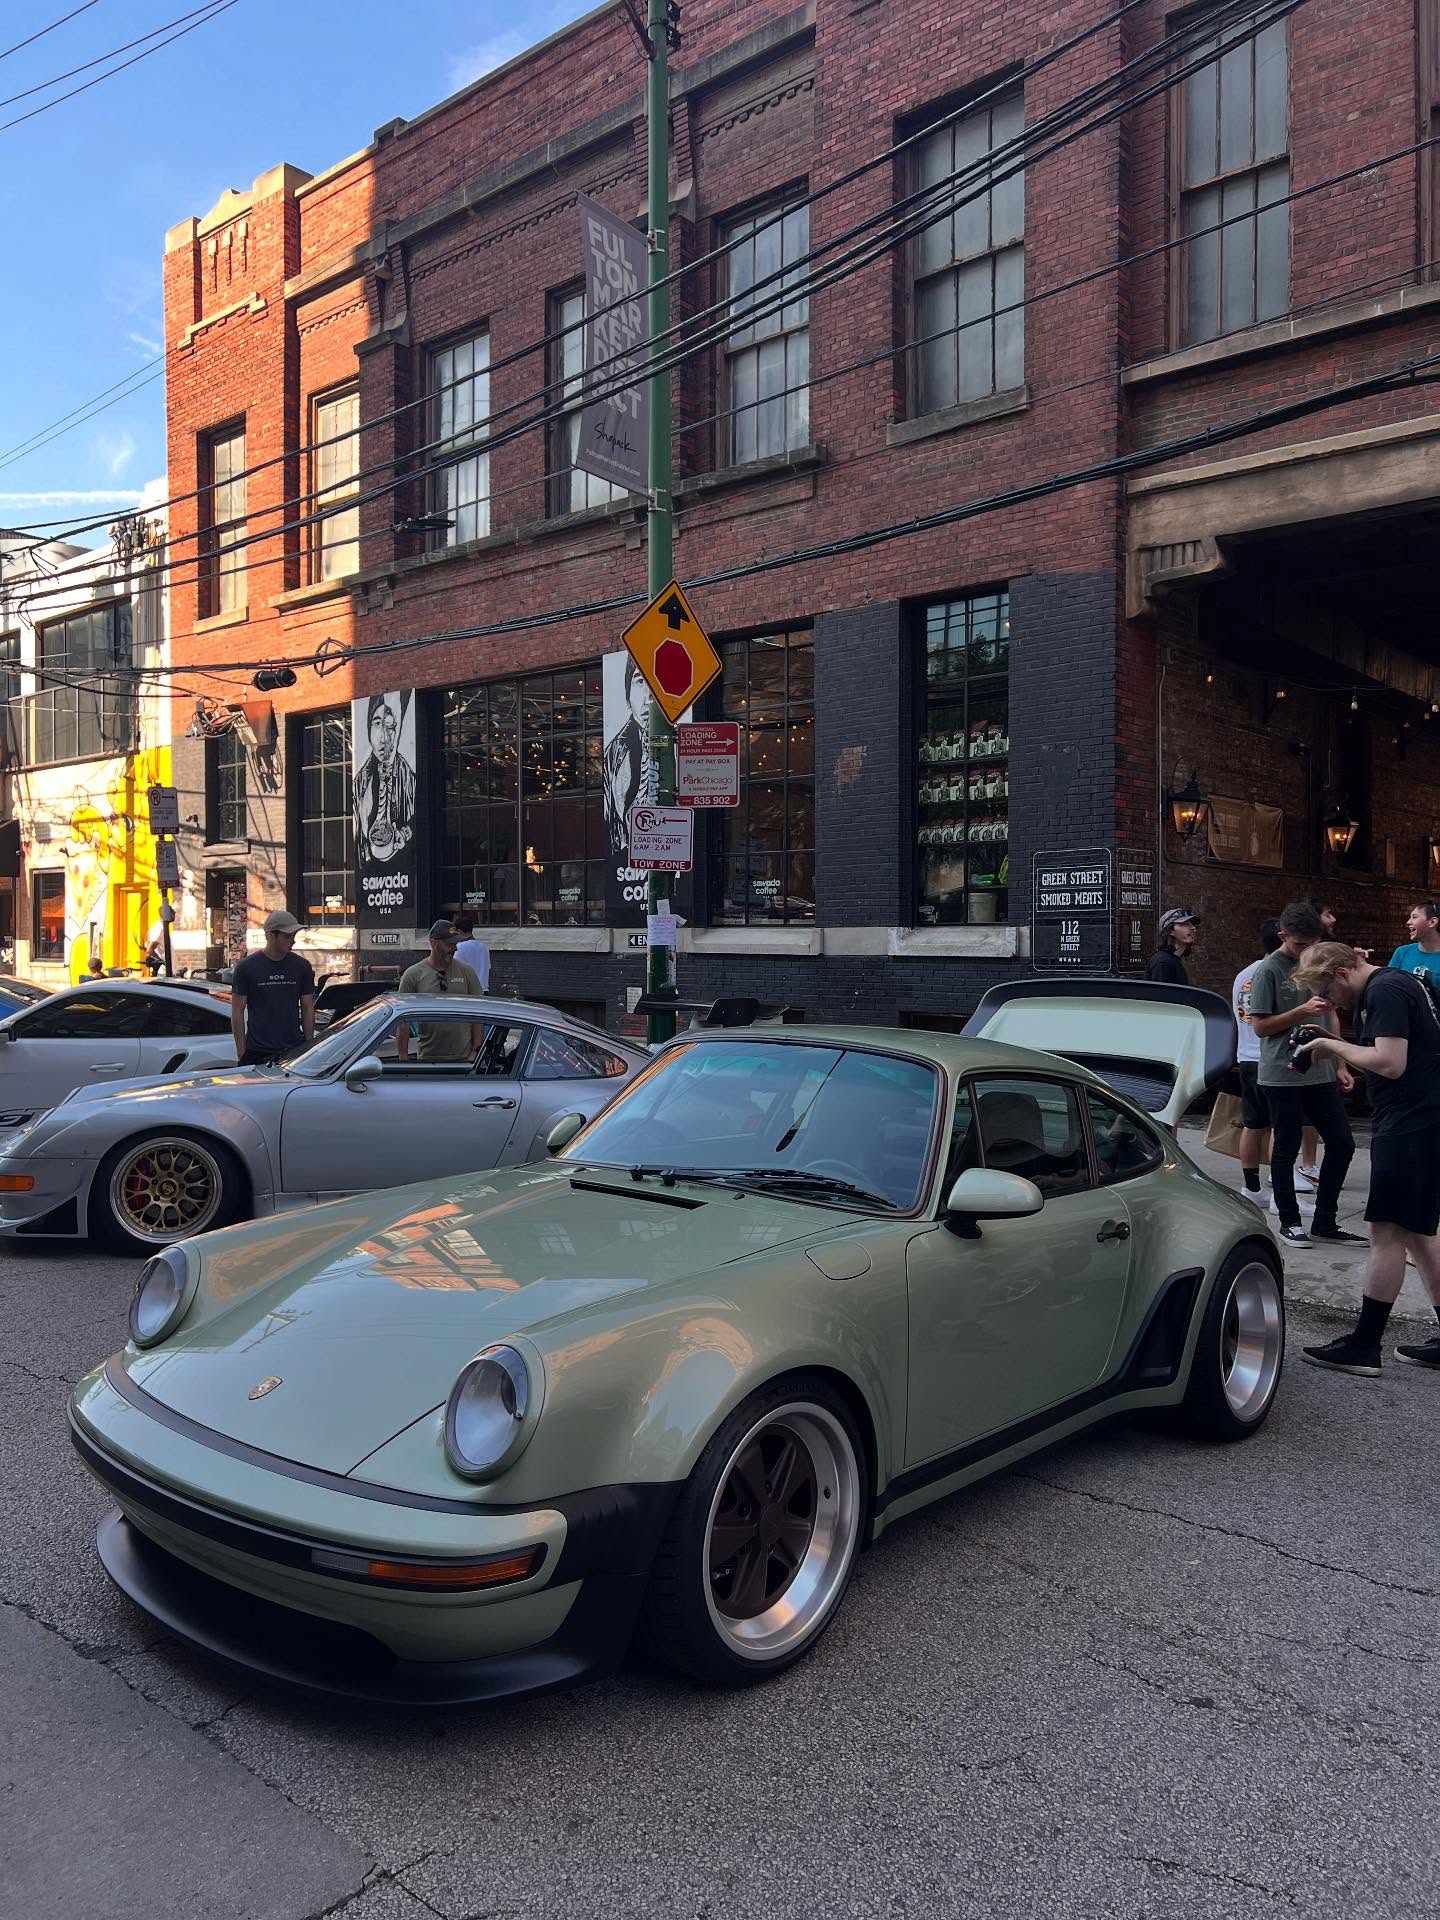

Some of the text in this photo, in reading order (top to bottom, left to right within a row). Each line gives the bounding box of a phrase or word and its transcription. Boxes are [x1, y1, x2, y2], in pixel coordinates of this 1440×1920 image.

[587, 216, 633, 271] FUL
[590, 246, 638, 303] TON
[592, 275, 642, 335] MAR
[593, 304, 636, 350] KET
[683, 776, 733, 786] ParkChicago
[693, 796, 731, 805] 835 902
[665, 837, 683, 845] ZONE
[632, 860, 686, 870] TOW ZONE
[362, 872, 409, 891] sawada
[752, 878, 781, 887] sawada
[1041, 871, 1104, 886] GREEN STREET
[367, 889, 404, 907] coffee
[623, 881, 648, 901] cof
[755, 887, 778, 895] coffee
[1040, 891, 1104, 906] SMOKED MEATS
[1061, 920, 1079, 935] 112
[1131, 920, 1141, 935] 112
[378, 934, 398, 943] ENTER
[1060, 935, 1080, 943] N GREEN
[1060, 943, 1080, 951] STREET
